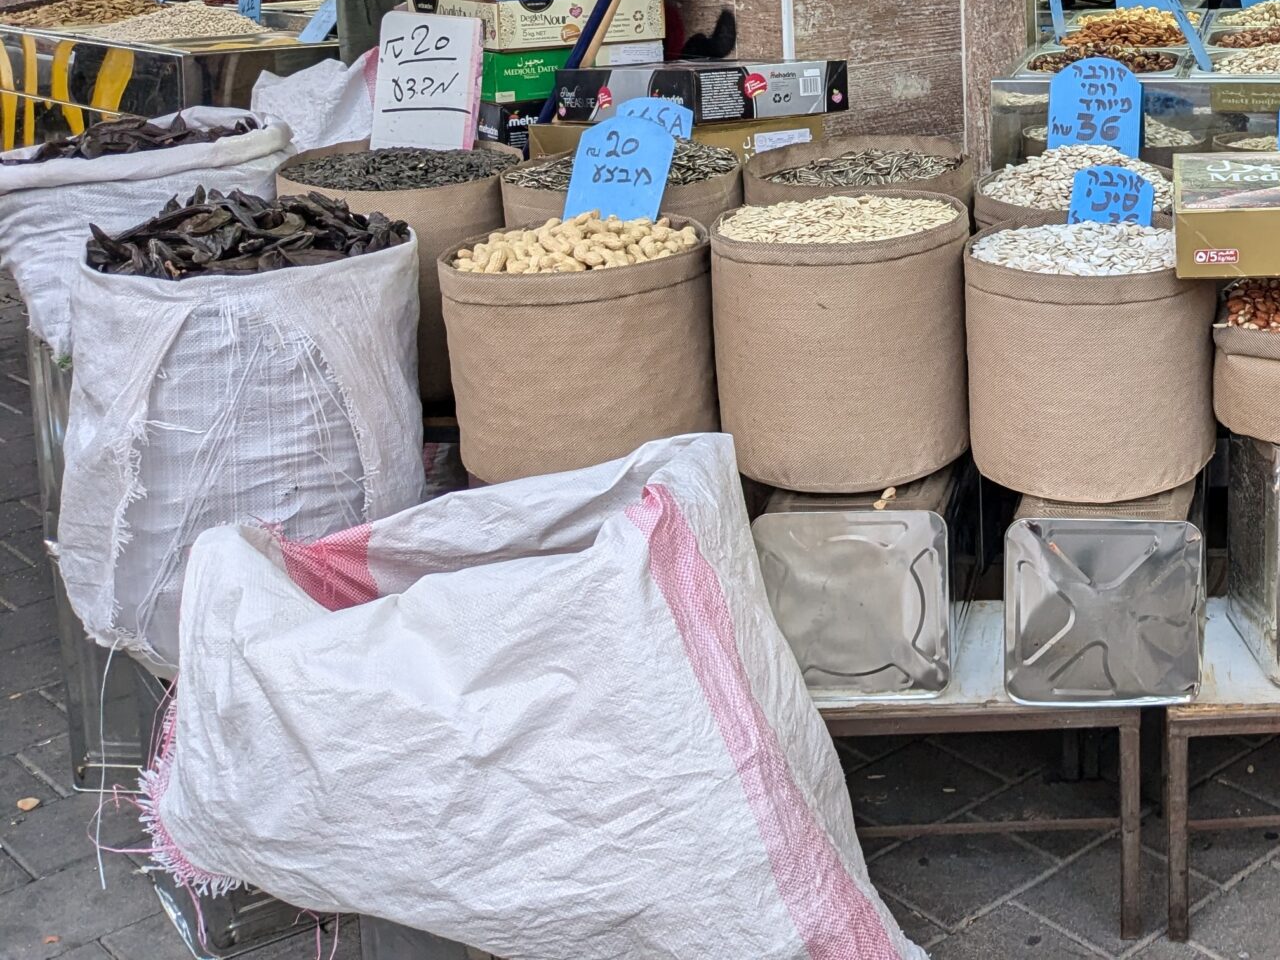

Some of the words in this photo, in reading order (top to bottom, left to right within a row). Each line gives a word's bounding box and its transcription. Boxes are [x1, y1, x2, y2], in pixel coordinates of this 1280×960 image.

[520, 14, 544, 24] Deglet
[411, 24, 450, 56] 20
[1080, 83, 1118, 96] רוסי
[1079, 97, 1133, 113] מיוחד
[1076, 113, 1122, 141] 36
[605, 130, 640, 158] 20
[592, 164, 652, 187] מבצע
[1085, 189, 1140, 212] סיני
